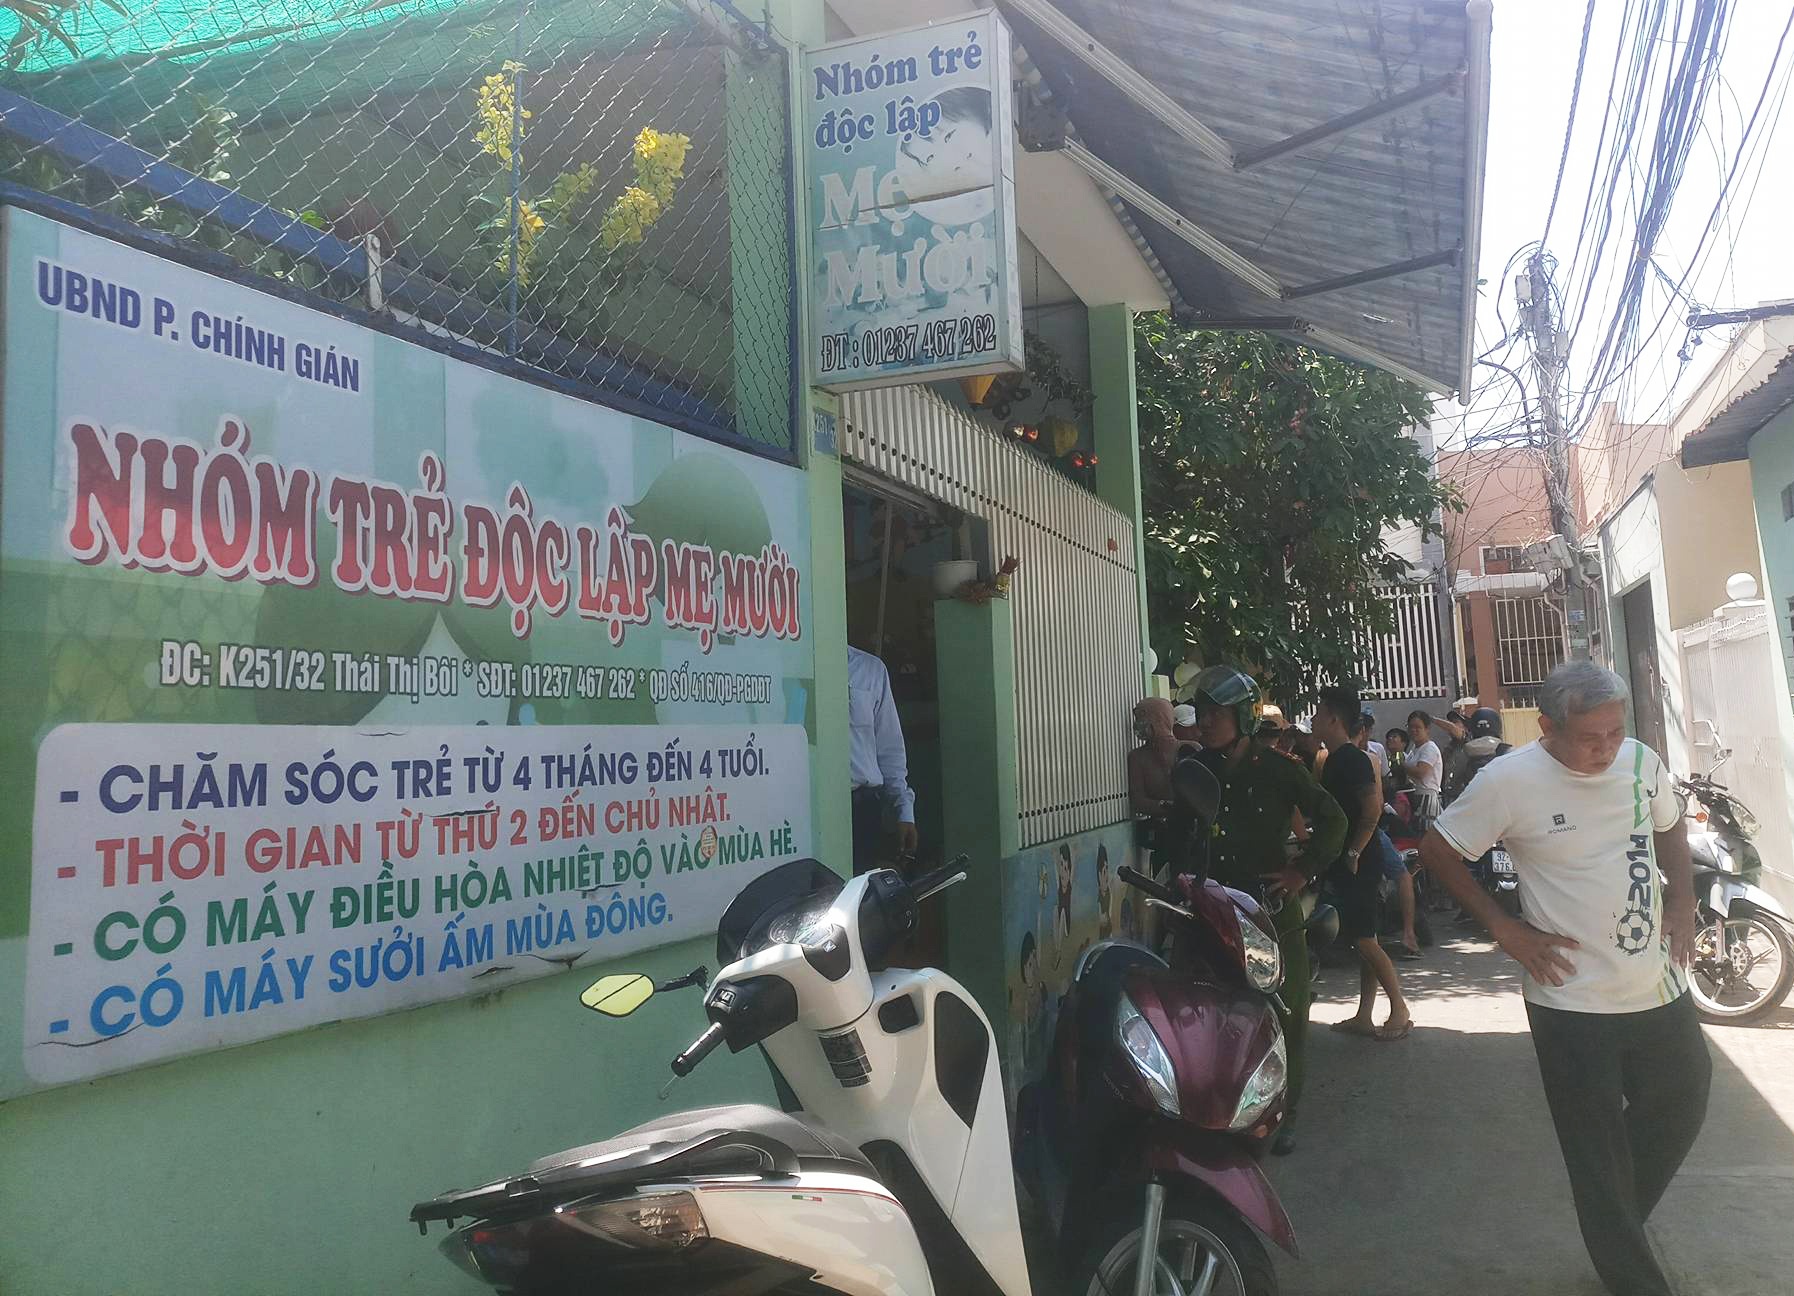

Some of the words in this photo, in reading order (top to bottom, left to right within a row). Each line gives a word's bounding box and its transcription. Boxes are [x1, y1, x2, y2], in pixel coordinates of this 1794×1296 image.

[813, 54, 918, 100] Nhóm
[927, 30, 982, 77] trẻ
[815, 108, 874, 153] độc
[884, 96, 942, 142] lập
[819, 165, 914, 237] Mẹ
[38, 261, 141, 329] UBND
[153, 297, 178, 342] P.
[191, 311, 285, 371] CHÍNH
[295, 344, 360, 393] GIÁN
[861, 325, 918, 368] 01237
[922, 319, 957, 359] 467
[960, 313, 996, 353] 262
[328, 450, 454, 605] TRẺ
[461, 481, 569, 640] ĐỘC
[576, 505, 658, 647] LẬP
[662, 539, 718, 655] MẸ
[719, 541, 800, 641] MƯỜI
[160, 640, 211, 686] ĐC:
[219, 644, 326, 690] K251/32
[331, 652, 380, 693] Thái
[386, 655, 419, 703] Thị
[424, 656, 458, 696] Bôi
[477, 660, 517, 698] SĐT:
[521, 663, 572, 698] 01237
[576, 666, 604, 699] 467
[608, 667, 636, 700] 262
[670, 661, 689, 702] SỐ
[99, 751, 268, 814] CHĂM
[284, 749, 378, 805] SÓC
[391, 743, 452, 800] TRẺ
[463, 744, 505, 794] TỪ
[512, 756, 532, 791] 4
[541, 743, 638, 789] THÁNG
[646, 737, 692, 783] ĐẾN
[699, 754, 713, 780] 4
[718, 732, 769, 777] TUỔI.
[95, 818, 226, 888] THỜI
[245, 823, 361, 874] GIAN
[375, 807, 423, 861] TỪ
[433, 802, 500, 856] THỨ
[510, 809, 528, 846] 2
[538, 789, 595, 842] ĐẾN
[604, 787, 660, 834] CHỦ
[668, 785, 731, 828] NHẬT.
[93, 890, 187, 961] CÓ
[206, 880, 315, 947] MÁY
[329, 859, 420, 928] ĐIỀU
[435, 859, 513, 914] HÒA
[523, 843, 605, 899] NHIỆT
[612, 838, 652, 888] ĐỘ
[718, 825, 764, 866] MÙA
[769, 819, 797, 857] HÈ.
[90, 962, 184, 1036] CÓ
[203, 947, 315, 1018] MÁY
[328, 925, 425, 993] SƯỞI
[437, 911, 494, 973] ẤM
[506, 902, 576, 956] MÙA
[585, 892, 673, 938] ĐÔNG.
